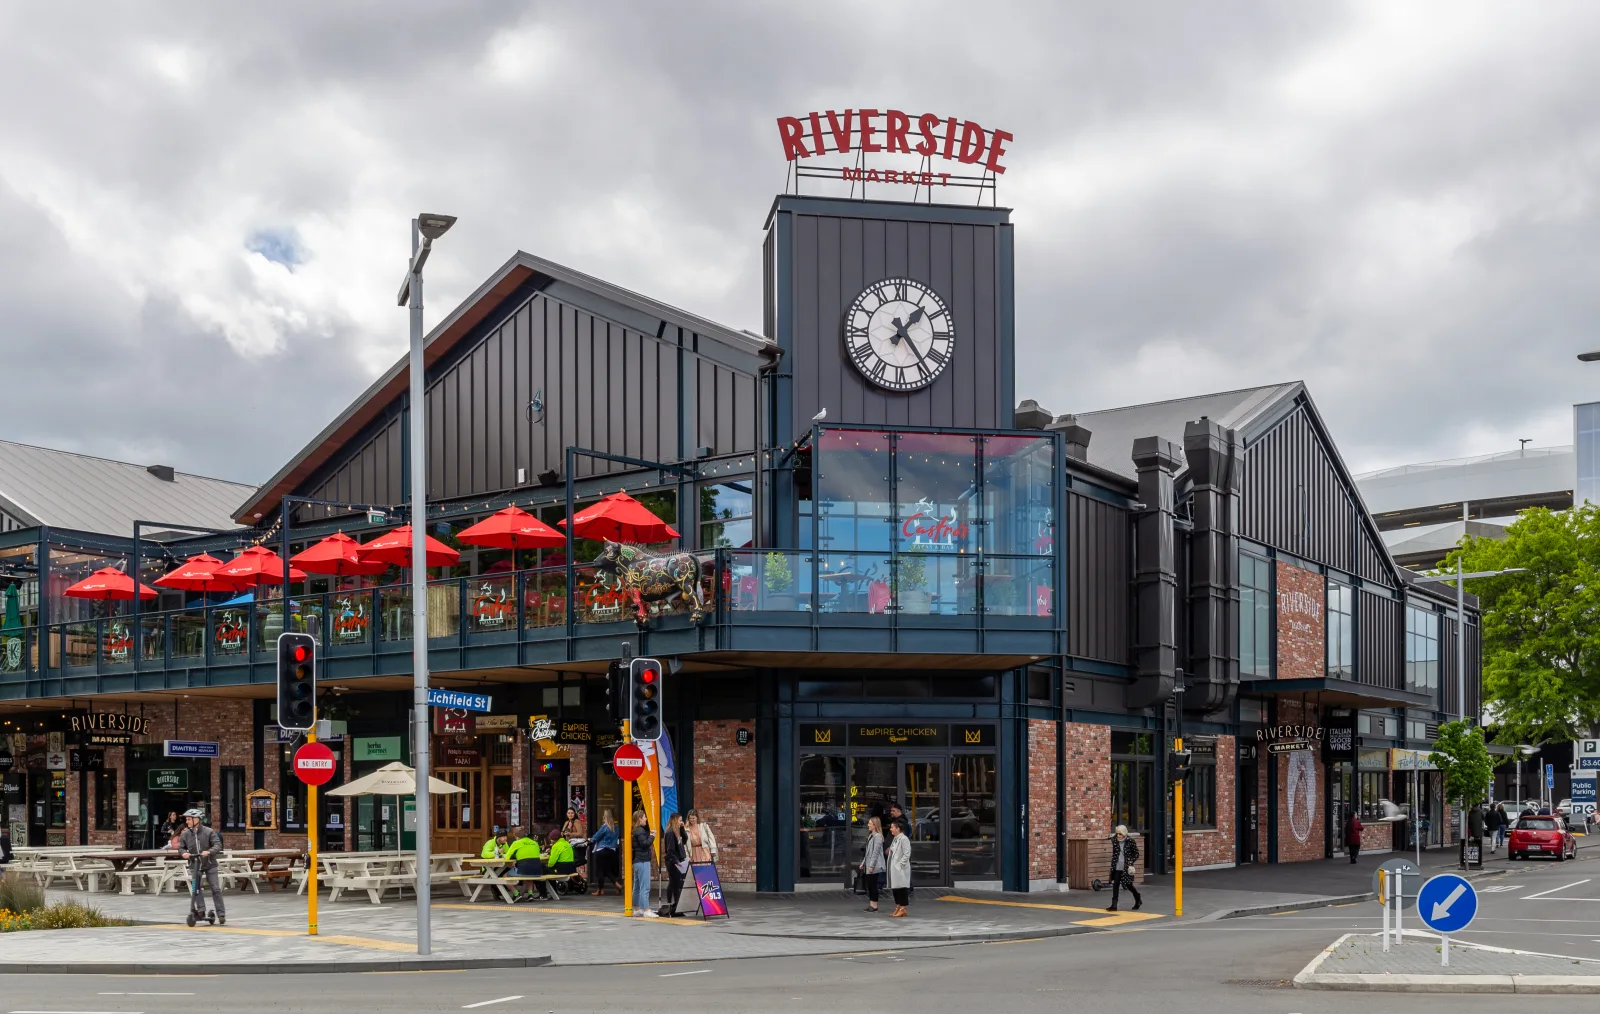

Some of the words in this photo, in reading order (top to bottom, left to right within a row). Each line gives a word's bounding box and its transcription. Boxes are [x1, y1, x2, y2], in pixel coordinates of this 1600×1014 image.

[777, 108, 1014, 175] RIVERSIDE
[842, 166, 951, 187] MARKET
[902, 512, 969, 542] Castro's
[427, 691, 473, 707] Lichfield
[474, 696, 486, 709] St
[71, 713, 151, 735] RIVERSIDE
[562, 722, 589, 732] EMPIRE
[560, 731, 592, 741] CHICKEN
[860, 727, 895, 736] EMPIRE
[897, 727, 937, 737] CHICKEN
[1256, 725, 1323, 742] RIVERSIDE
[1329, 727, 1352, 735] ITALIAN
[92, 736, 131, 744] MARKET
[1273, 743, 1305, 752] MARKET
[1329, 743, 1352, 751] WINES
[627, 759, 640, 767] ENTRY
[708, 891, 722, 900] 91.3
